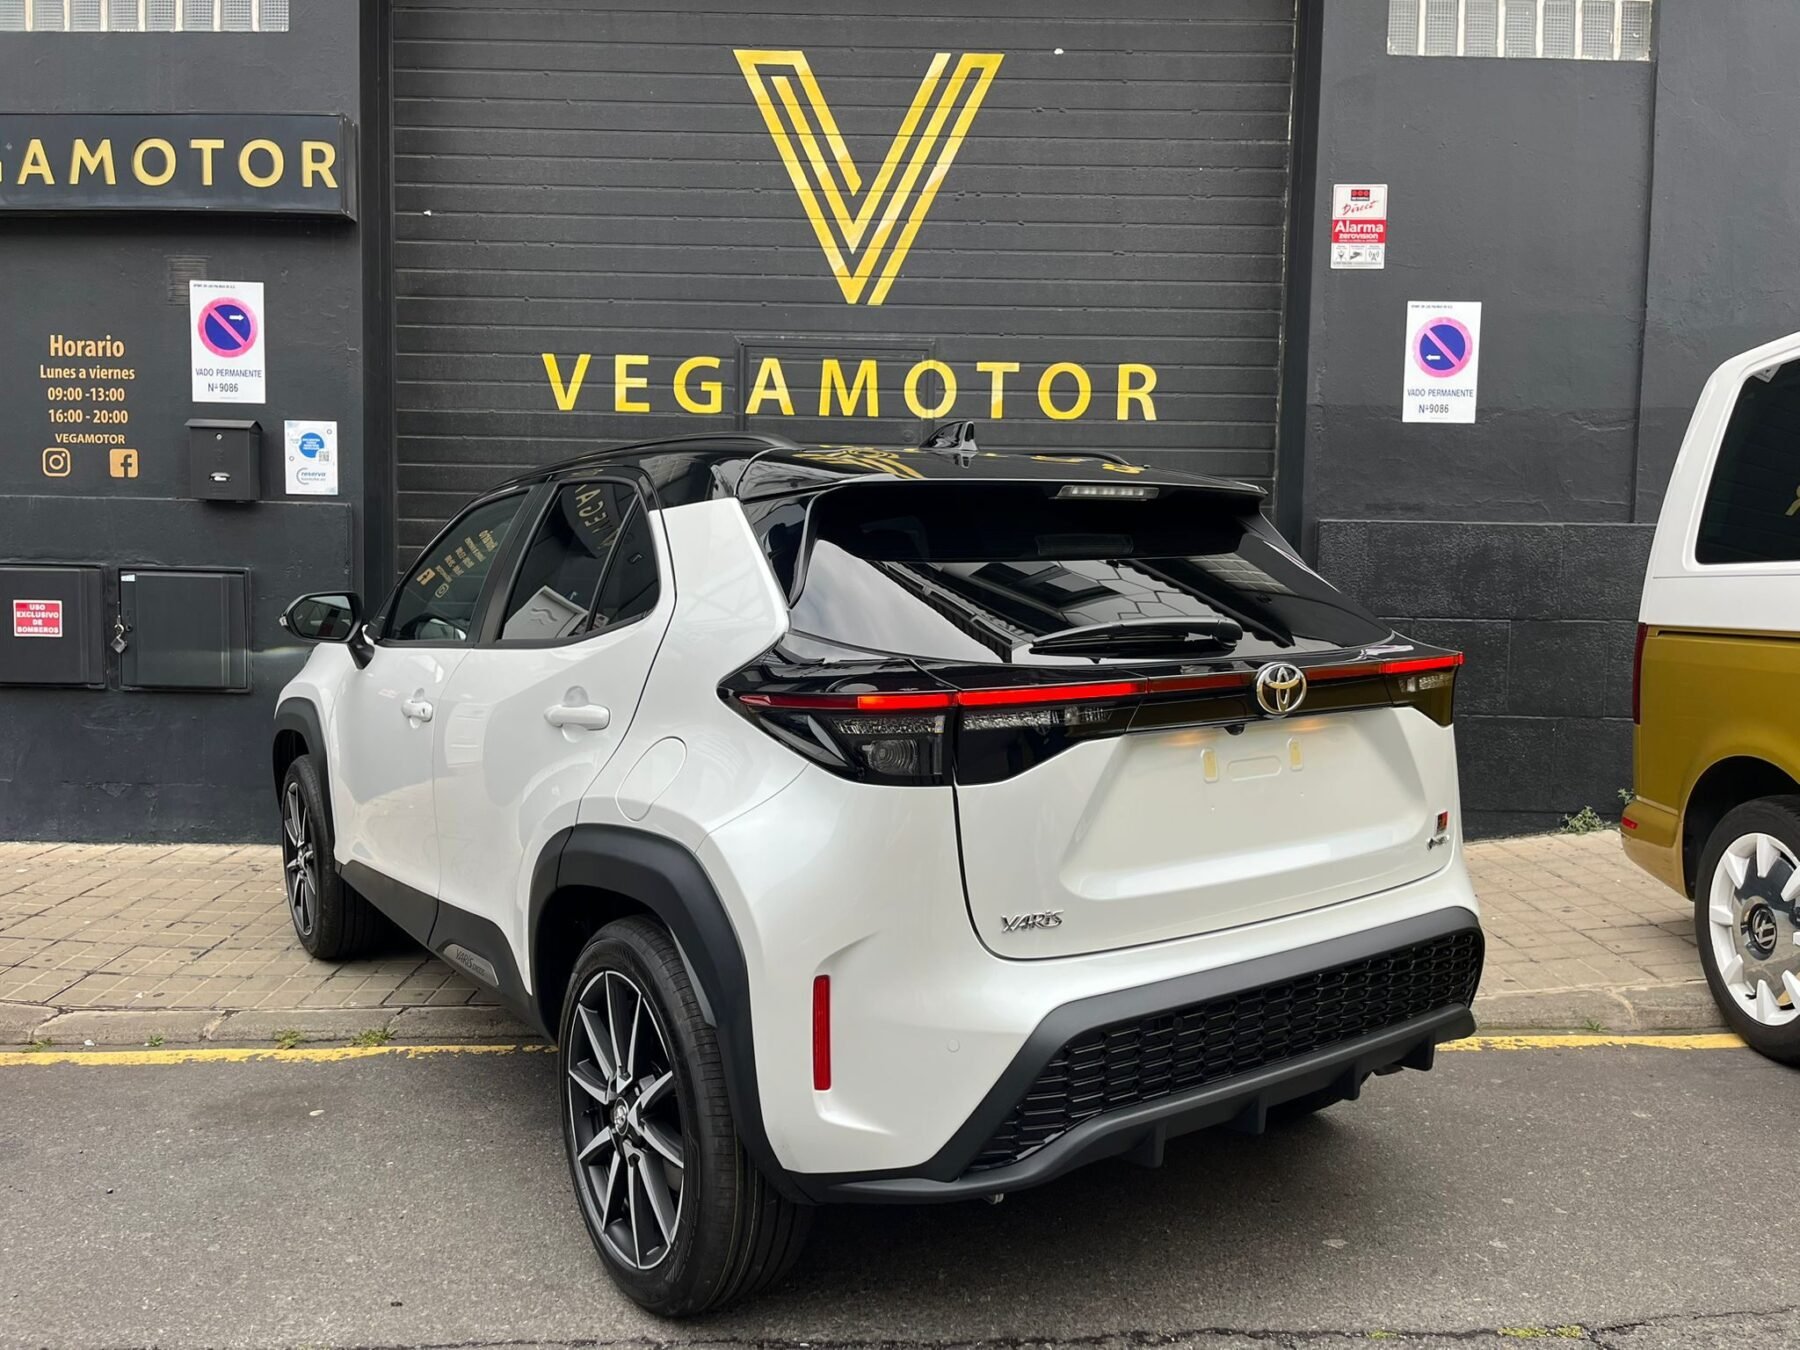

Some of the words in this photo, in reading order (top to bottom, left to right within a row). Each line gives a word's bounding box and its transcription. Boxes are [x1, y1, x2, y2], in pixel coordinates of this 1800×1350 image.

[0, 138, 339, 189] AMOTOR
[1334, 220, 1384, 233] Alarma
[50, 334, 125, 358] Horario
[40, 364, 77, 379] Lunes
[78, 368, 87, 379] a
[89, 364, 136, 380] viernes
[195, 368, 214, 376] VADO
[216, 368, 262, 378] PERMANENTE
[47, 386, 83, 401] 09:00
[541, 353, 1158, 422] VEGAMOTOR
[1407, 388, 1426, 397] VADO
[1428, 388, 1474, 398] PERMANENTE
[48, 408, 83, 423] 16:00
[92, 409, 129, 424] 20:00
[54, 433, 126, 444] VEGAMOTOR
